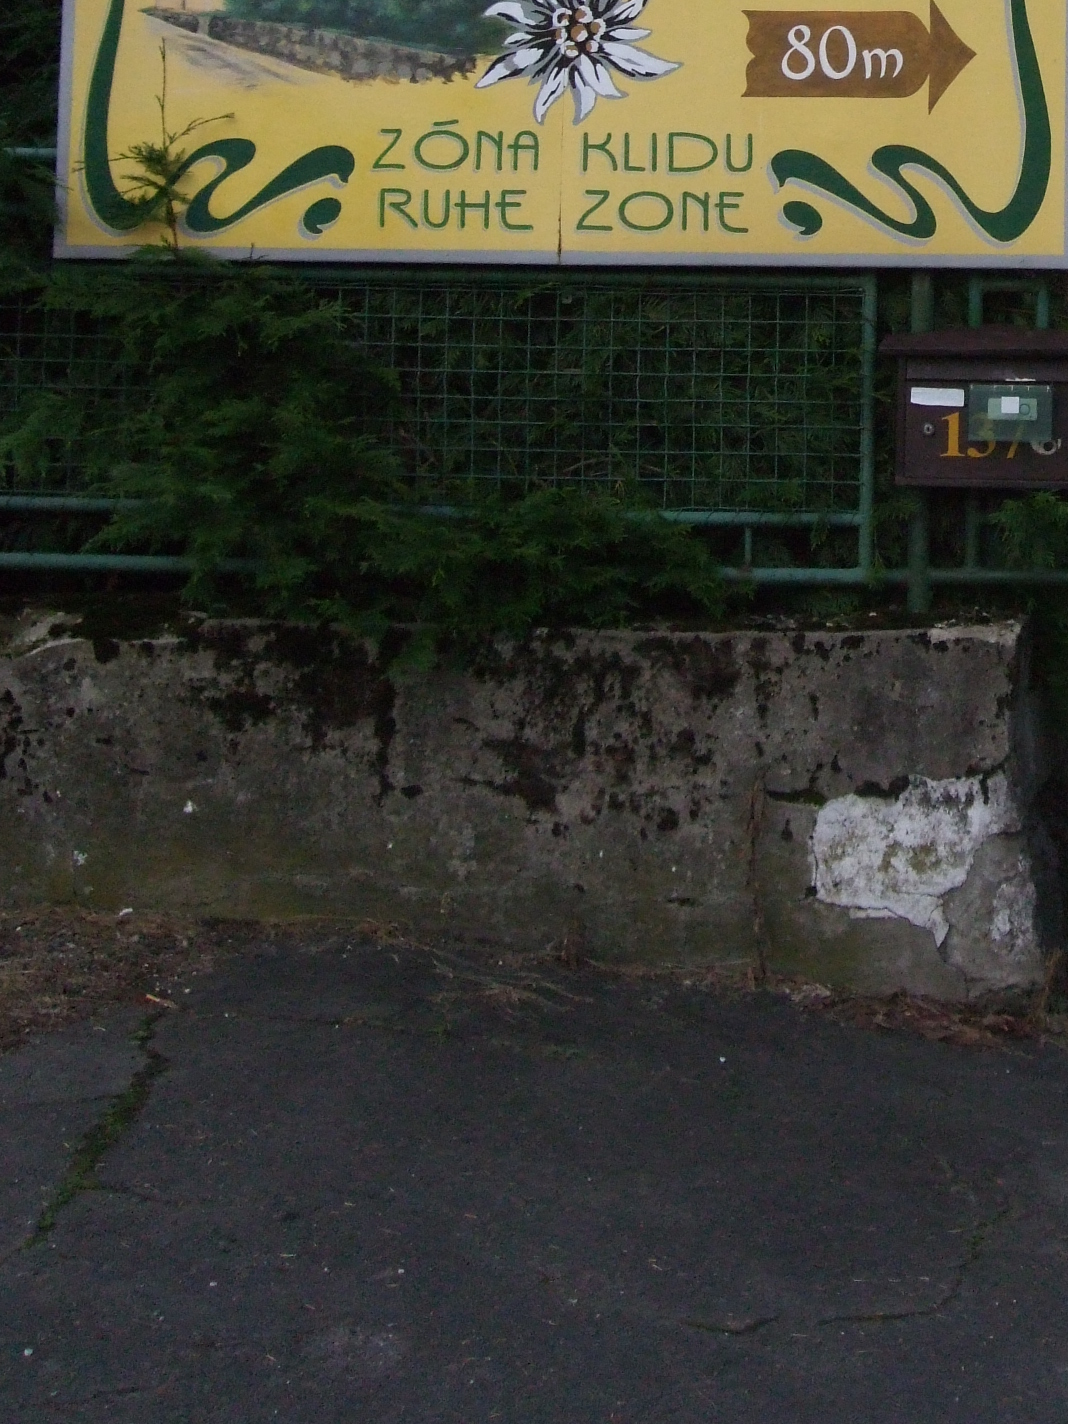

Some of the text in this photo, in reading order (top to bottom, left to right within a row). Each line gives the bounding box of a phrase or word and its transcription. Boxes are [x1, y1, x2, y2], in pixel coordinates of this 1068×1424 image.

[780, 24, 905, 81] 80m
[371, 119, 754, 174] ZÓNA KLIDU
[378, 188, 750, 235] RUHE ZONE
